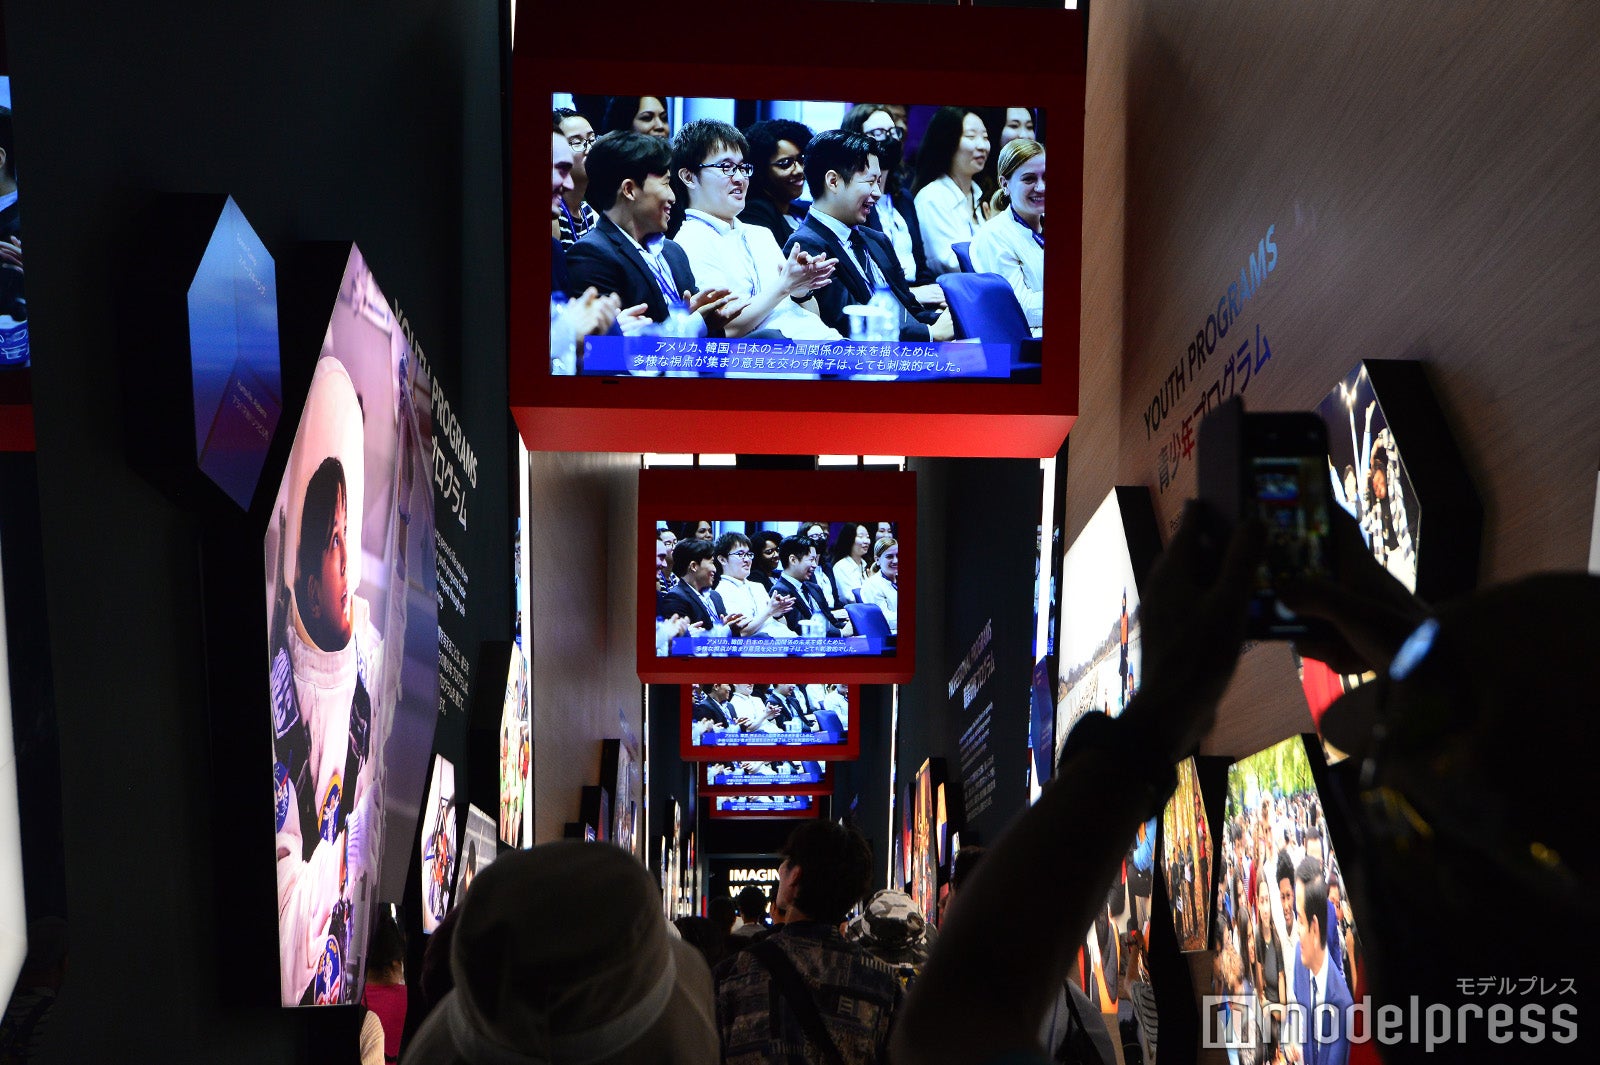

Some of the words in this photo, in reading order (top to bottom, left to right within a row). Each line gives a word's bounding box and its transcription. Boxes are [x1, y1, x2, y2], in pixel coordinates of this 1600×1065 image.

[1144, 358, 1186, 441] YOUTH
[1188, 223, 1278, 382] PROGRAMS
[431, 375, 477, 489] PROGRAMS
[728, 885, 773, 898] WT
[729, 868, 781, 882] IMAGIN
